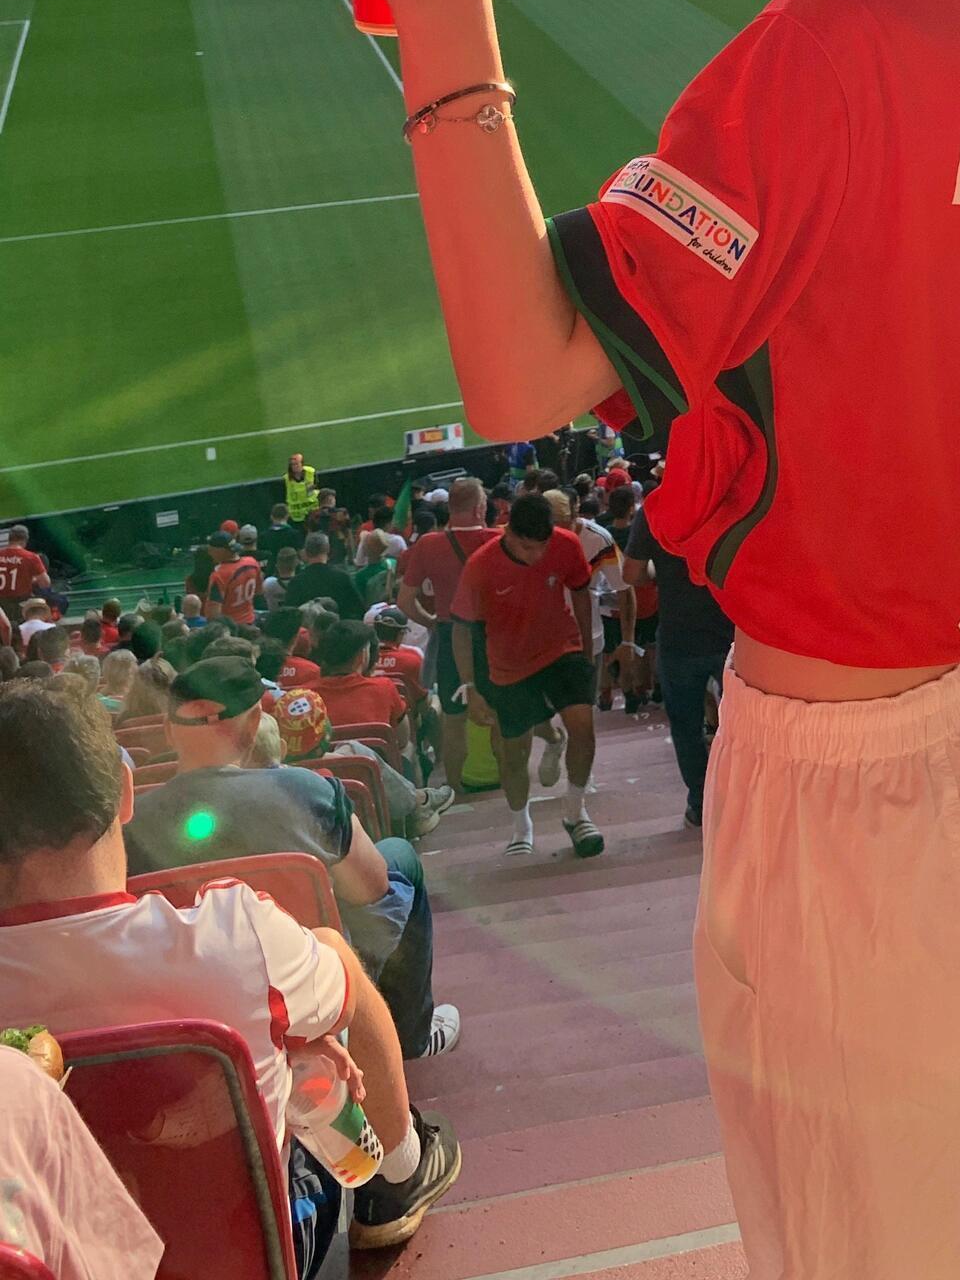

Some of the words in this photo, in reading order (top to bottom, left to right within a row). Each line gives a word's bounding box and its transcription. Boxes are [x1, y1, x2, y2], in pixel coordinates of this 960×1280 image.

[615, 171, 747, 262] FOUNDATION
[687, 236, 702, 250] for
[702, 247, 733, 274] children
[233, 579, 257, 608] 10
